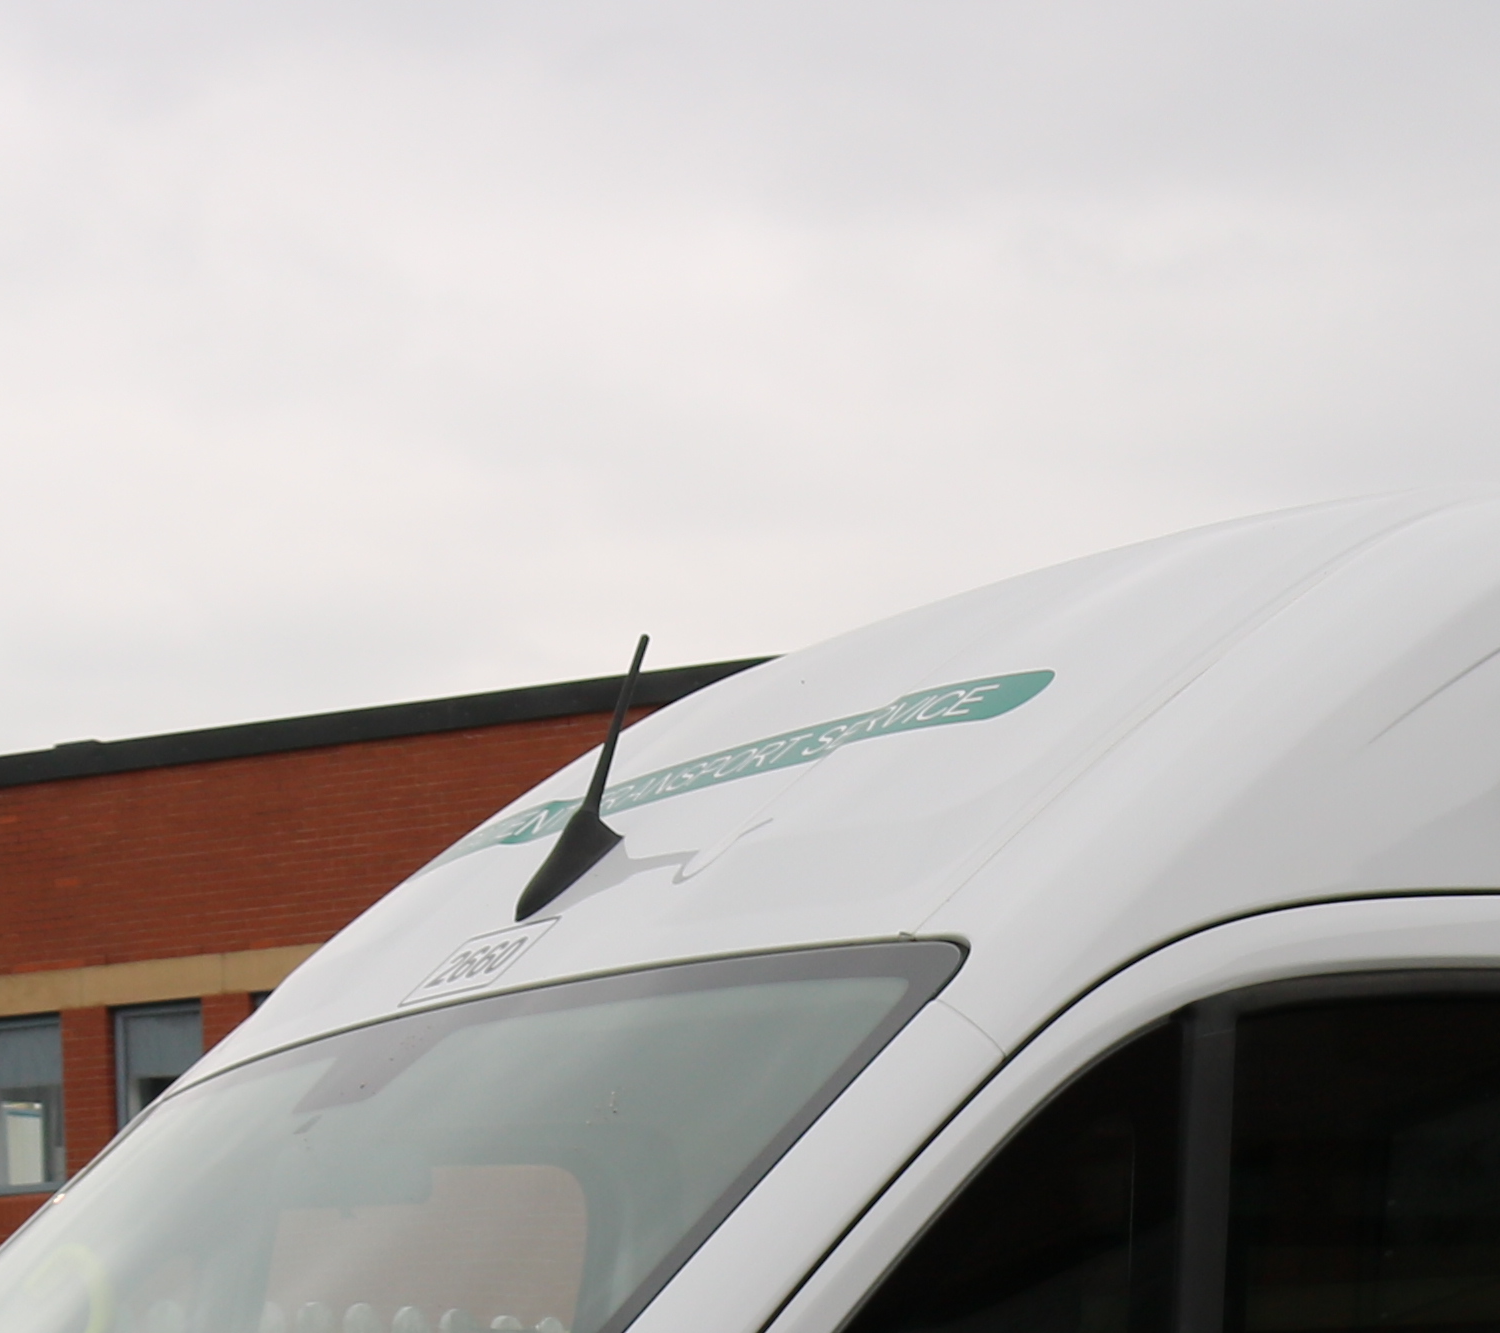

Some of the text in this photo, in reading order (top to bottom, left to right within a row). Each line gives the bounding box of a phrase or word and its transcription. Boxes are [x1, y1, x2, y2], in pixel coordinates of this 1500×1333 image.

[601, 684, 1000, 810] RANSPORT SERVICE
[424, 936, 529, 989] 2660
